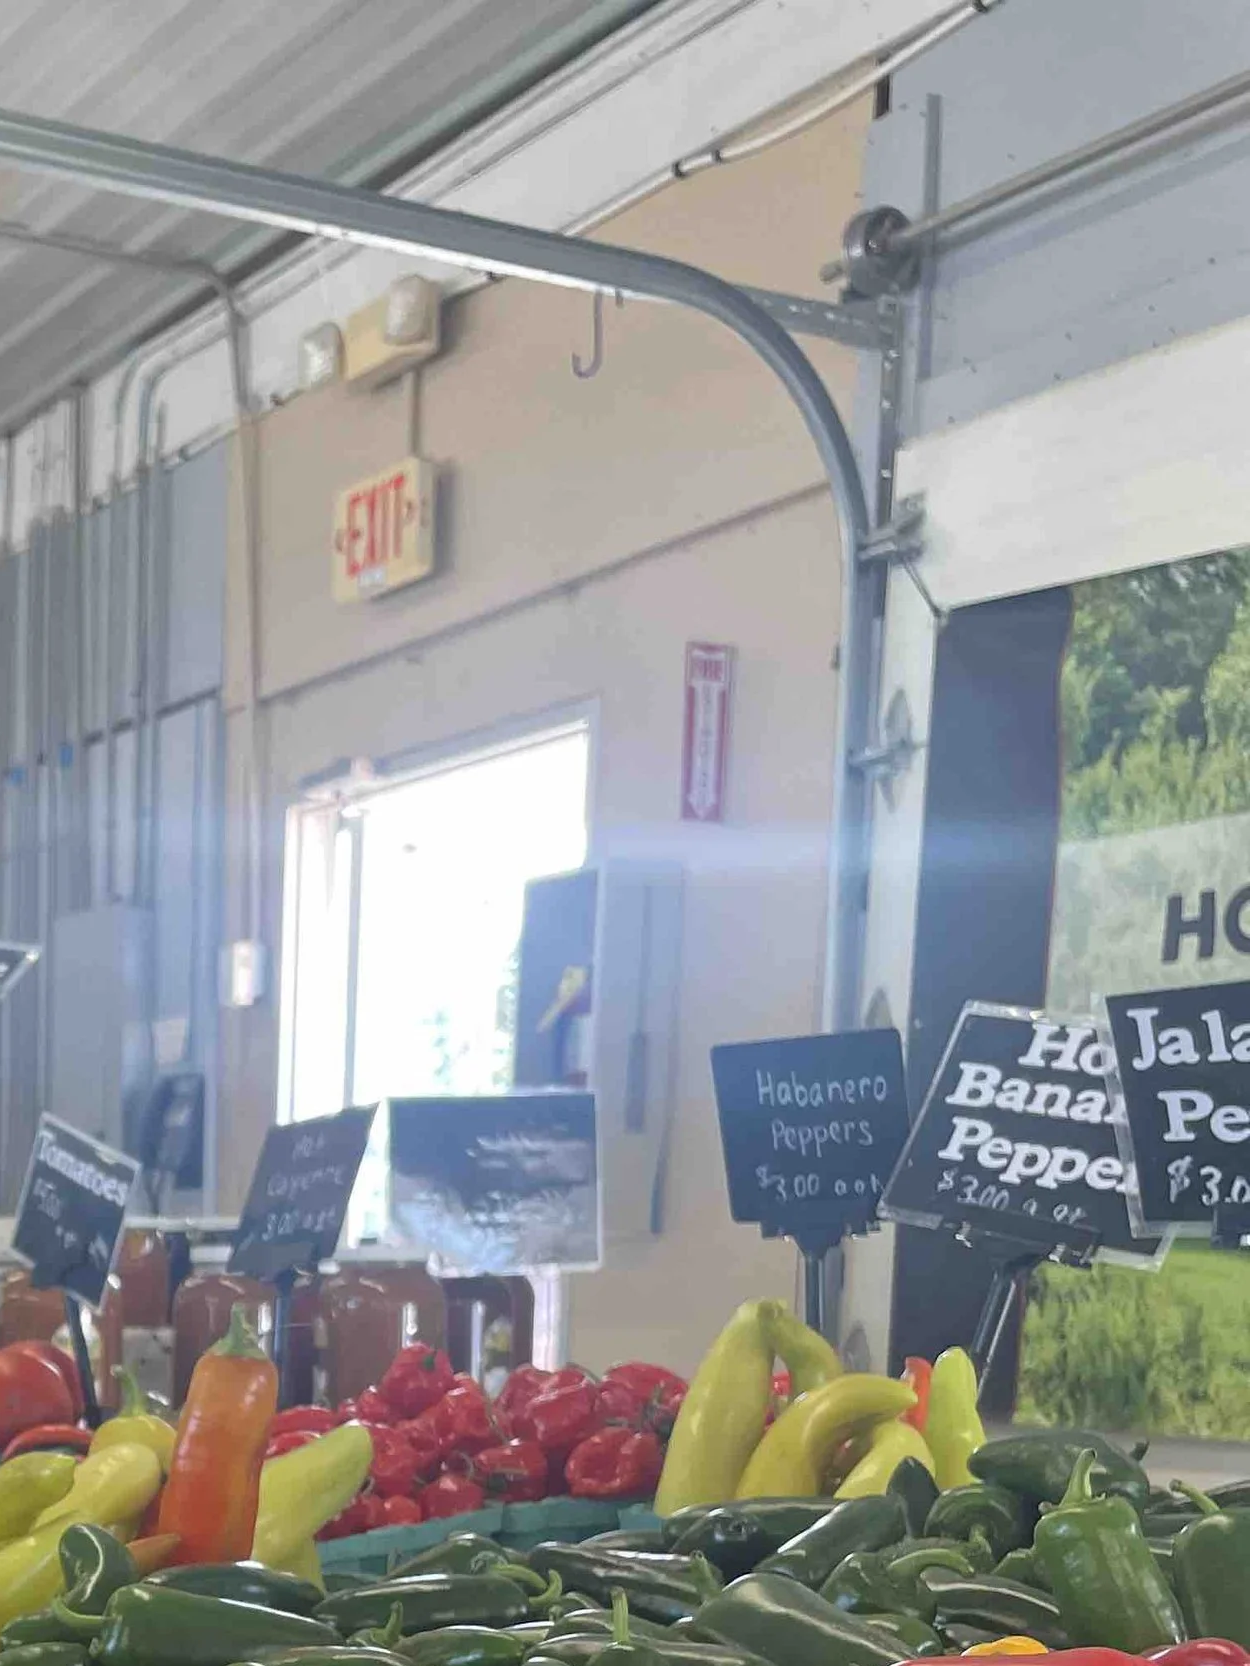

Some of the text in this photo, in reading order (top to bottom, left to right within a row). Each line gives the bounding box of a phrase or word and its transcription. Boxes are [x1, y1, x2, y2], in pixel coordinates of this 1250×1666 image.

[347, 473, 405, 579] EXIT
[756, 1069, 888, 1107] Habanero
[771, 1118, 873, 1158] Peppers
[37, 1130, 128, 1206] Tomatoes
